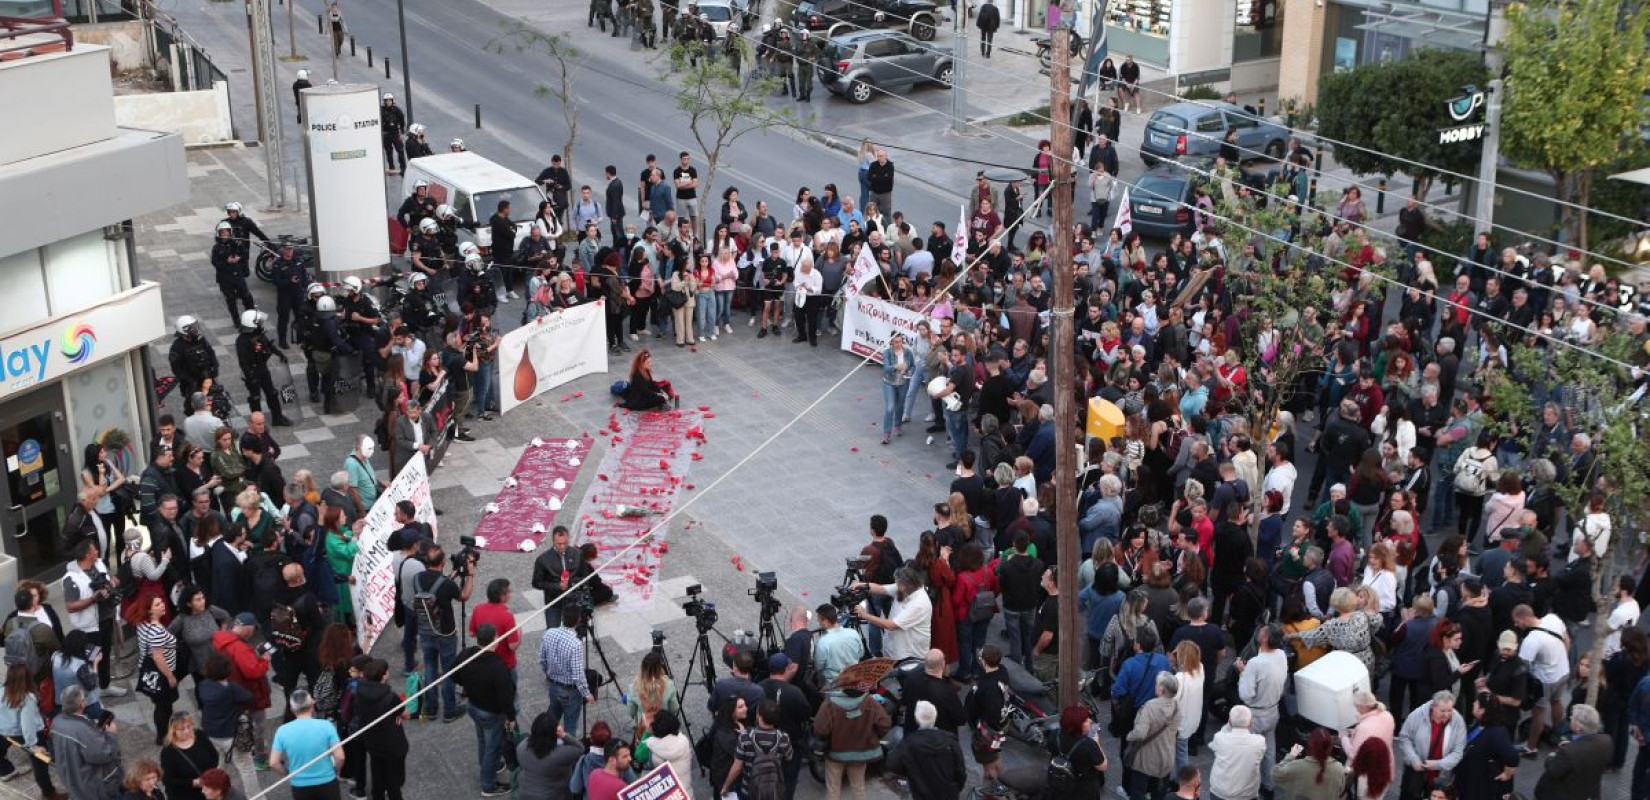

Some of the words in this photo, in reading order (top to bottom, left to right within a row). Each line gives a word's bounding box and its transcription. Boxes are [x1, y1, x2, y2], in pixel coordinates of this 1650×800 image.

[312, 123, 336, 131] POLICE
[354, 119, 378, 129] STATION
[1440, 125, 1484, 144] MOBBY
